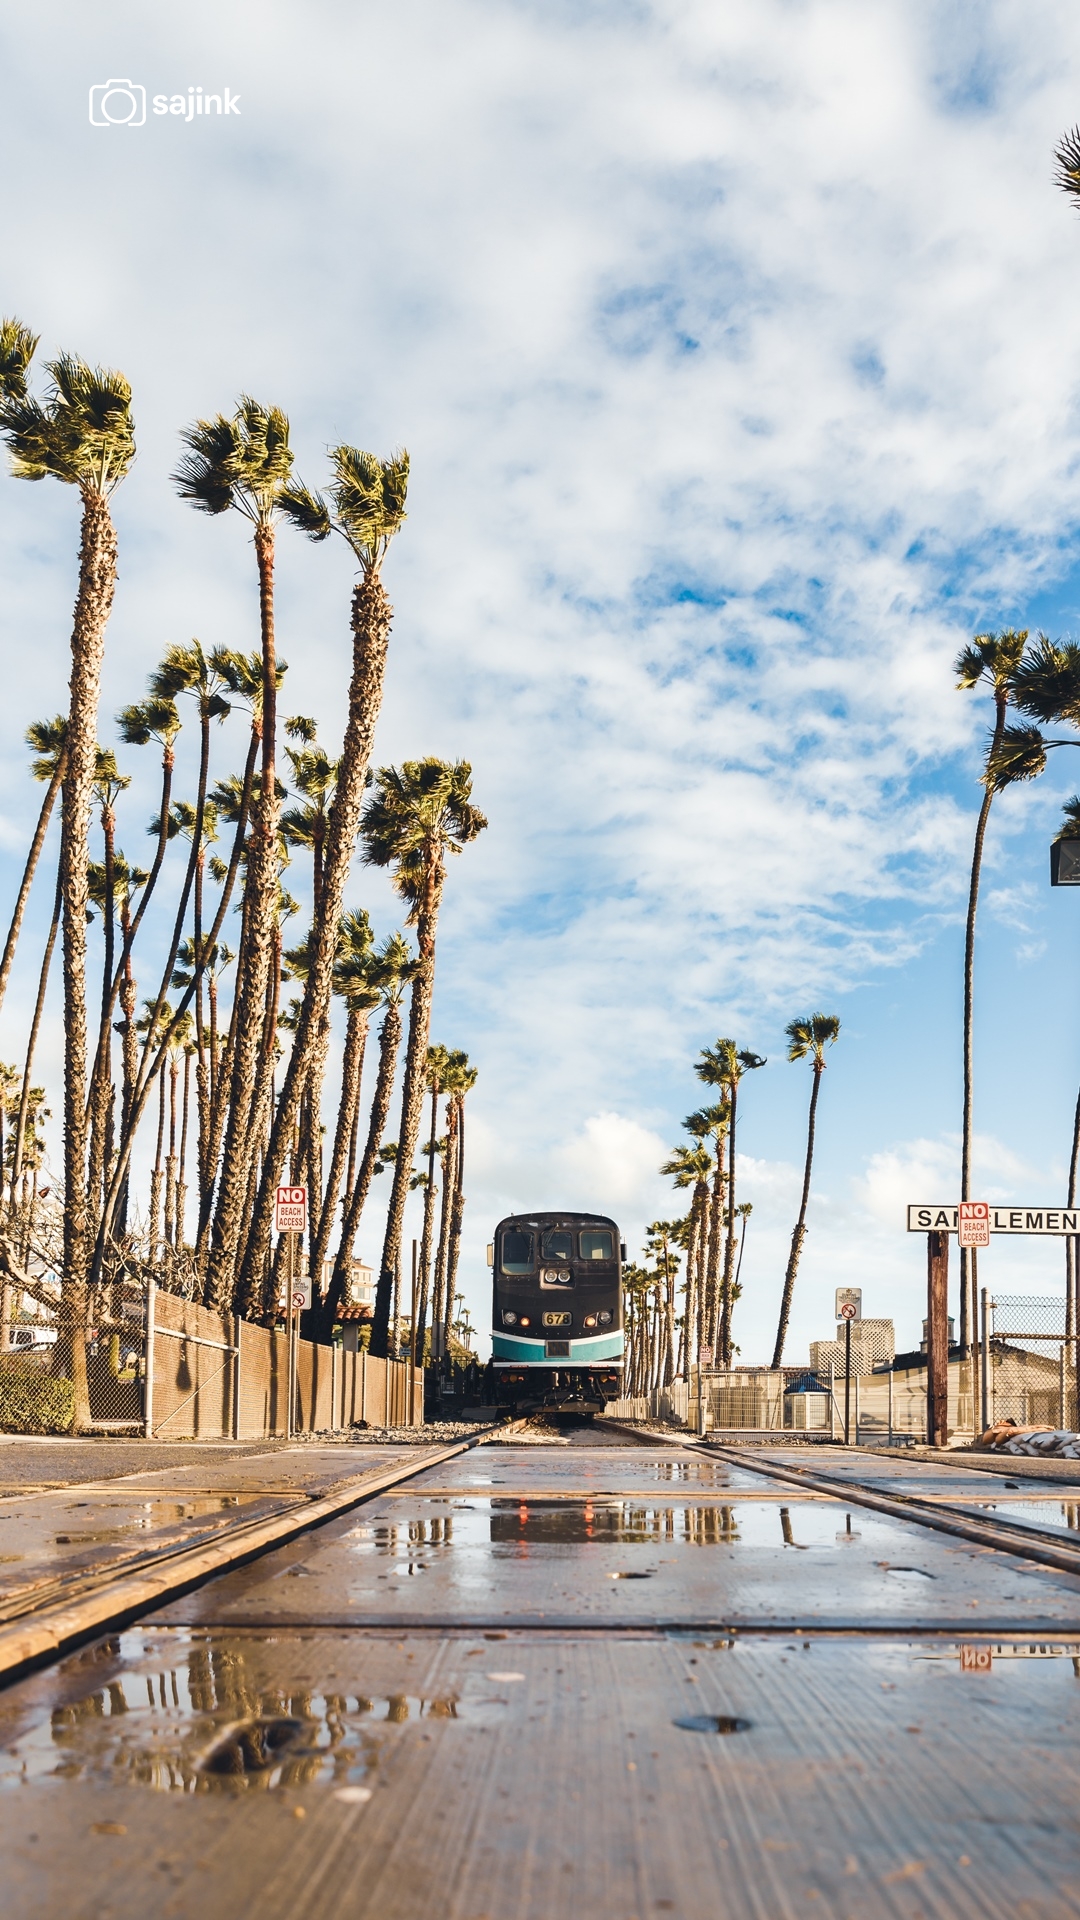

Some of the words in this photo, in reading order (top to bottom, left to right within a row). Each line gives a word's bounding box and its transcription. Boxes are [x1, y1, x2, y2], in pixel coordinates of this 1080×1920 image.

[278, 1189, 303, 1203] NO
[280, 1207, 301, 1216] BEACH
[961, 1204, 986, 1218] NO
[278, 1217, 303, 1226] ACCESS
[989, 1211, 1077, 1230] LEMEN
[964, 1222, 985, 1231] BEACH
[962, 1232, 987, 1242] ACCESS
[546, 1314, 570, 1325] 678
